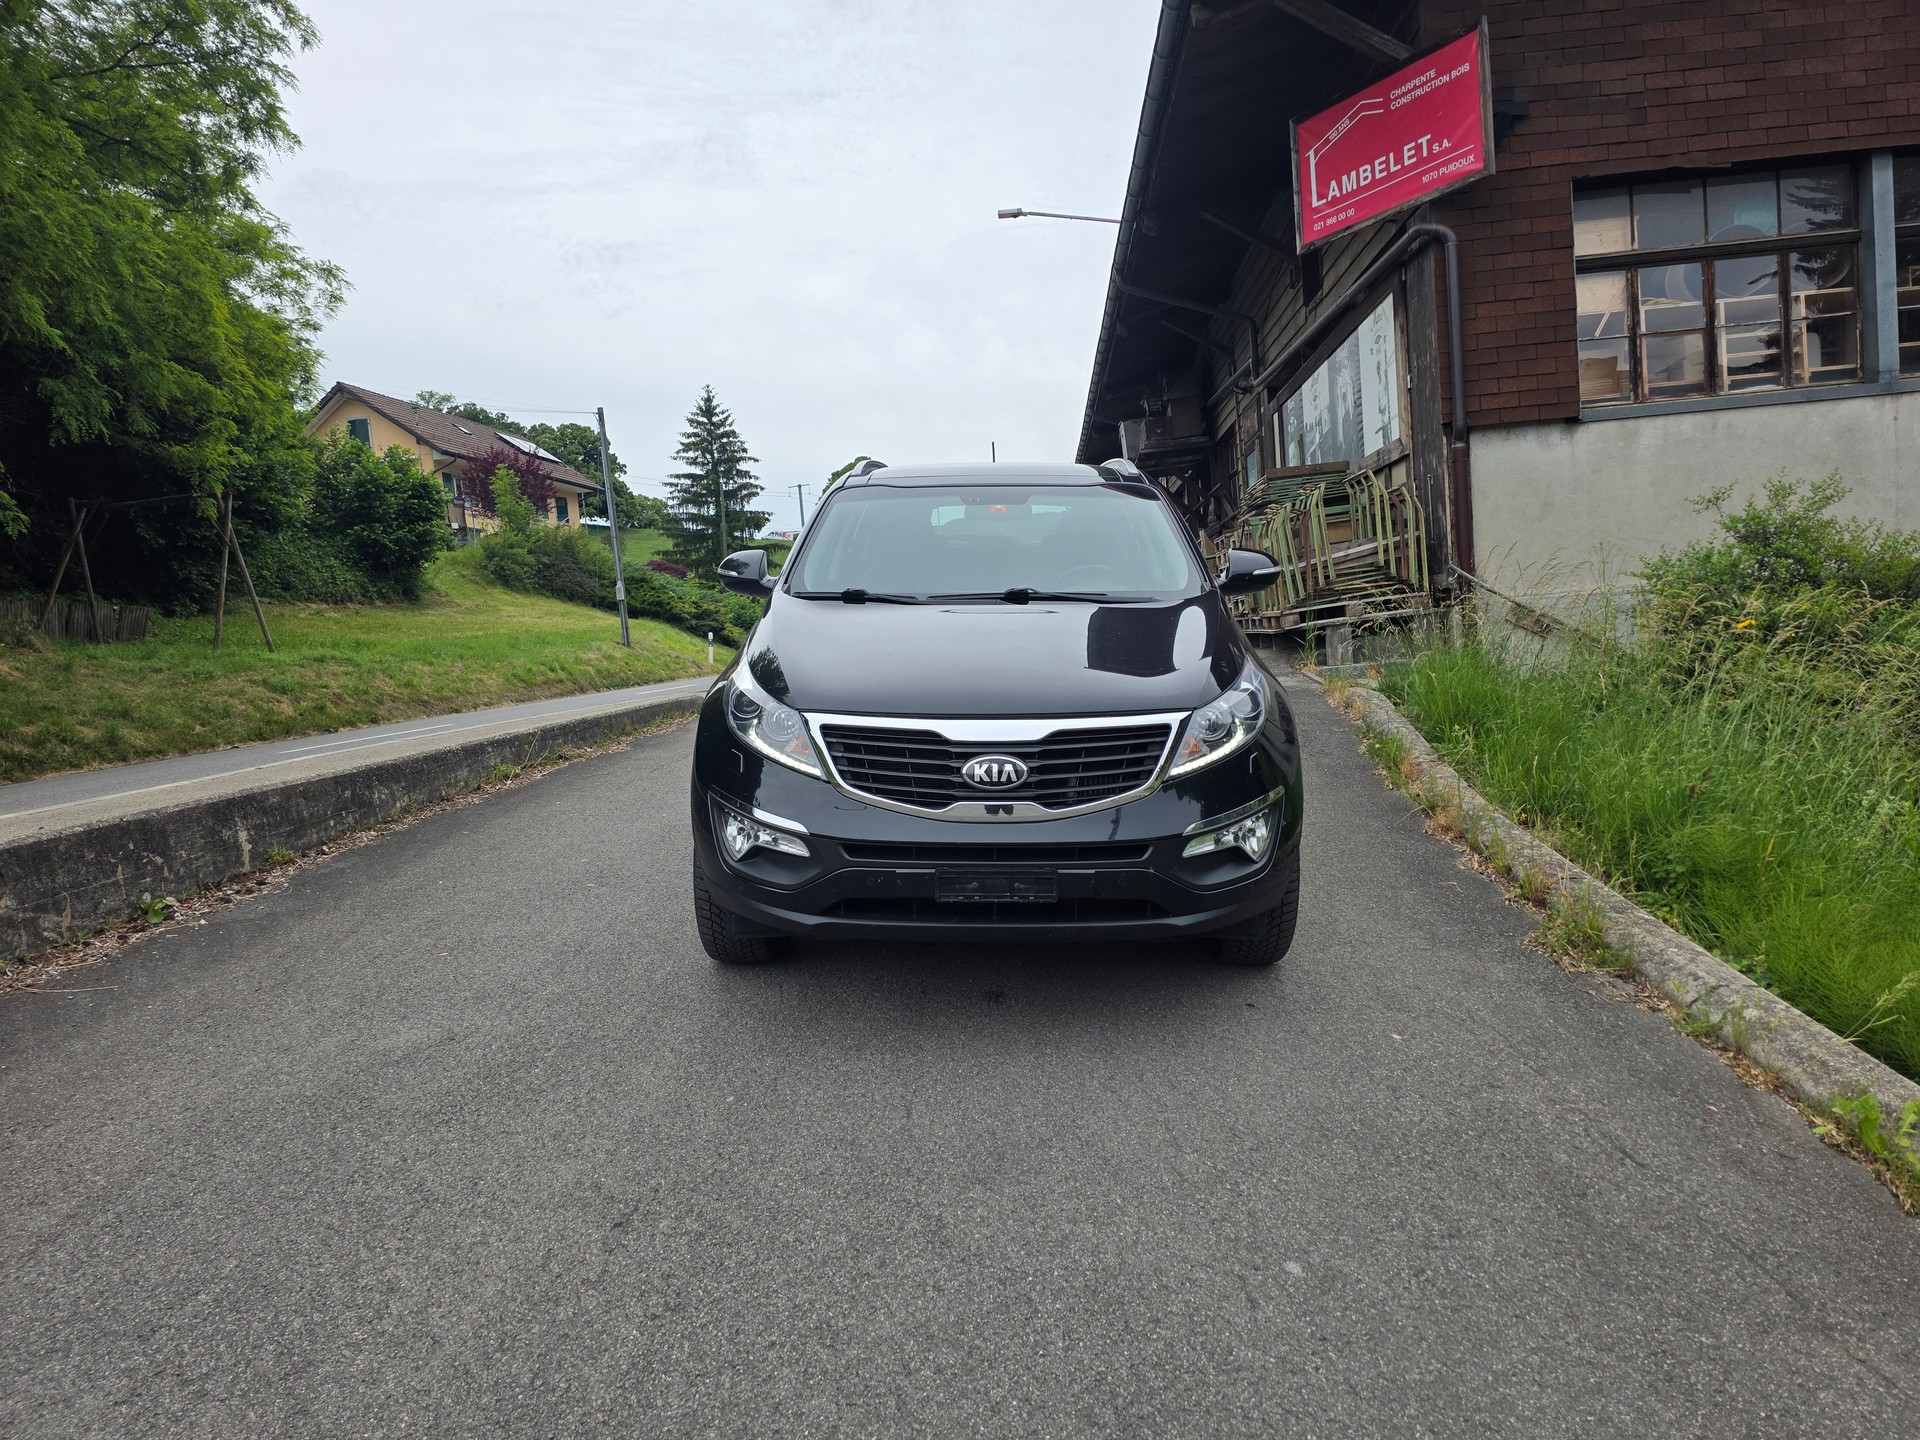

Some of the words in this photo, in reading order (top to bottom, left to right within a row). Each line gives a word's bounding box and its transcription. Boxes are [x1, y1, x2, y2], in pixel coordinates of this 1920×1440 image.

[1390, 68, 1436, 99] CHARPENTE
[1390, 73, 1449, 110] CONSTRUCTION
[1451, 62, 1470, 79] BOIS
[1309, 133, 1432, 208] LAMBELET
[1432, 138, 1452, 154] S.A.
[1421, 170, 1438, 184] 1070
[1439, 153, 1475, 176] PUIDOUX
[1313, 221, 1324, 231] 021
[1337, 211, 1346, 221] 00
[1346, 207, 1355, 217] 00
[973, 763, 1018, 782] KIA
